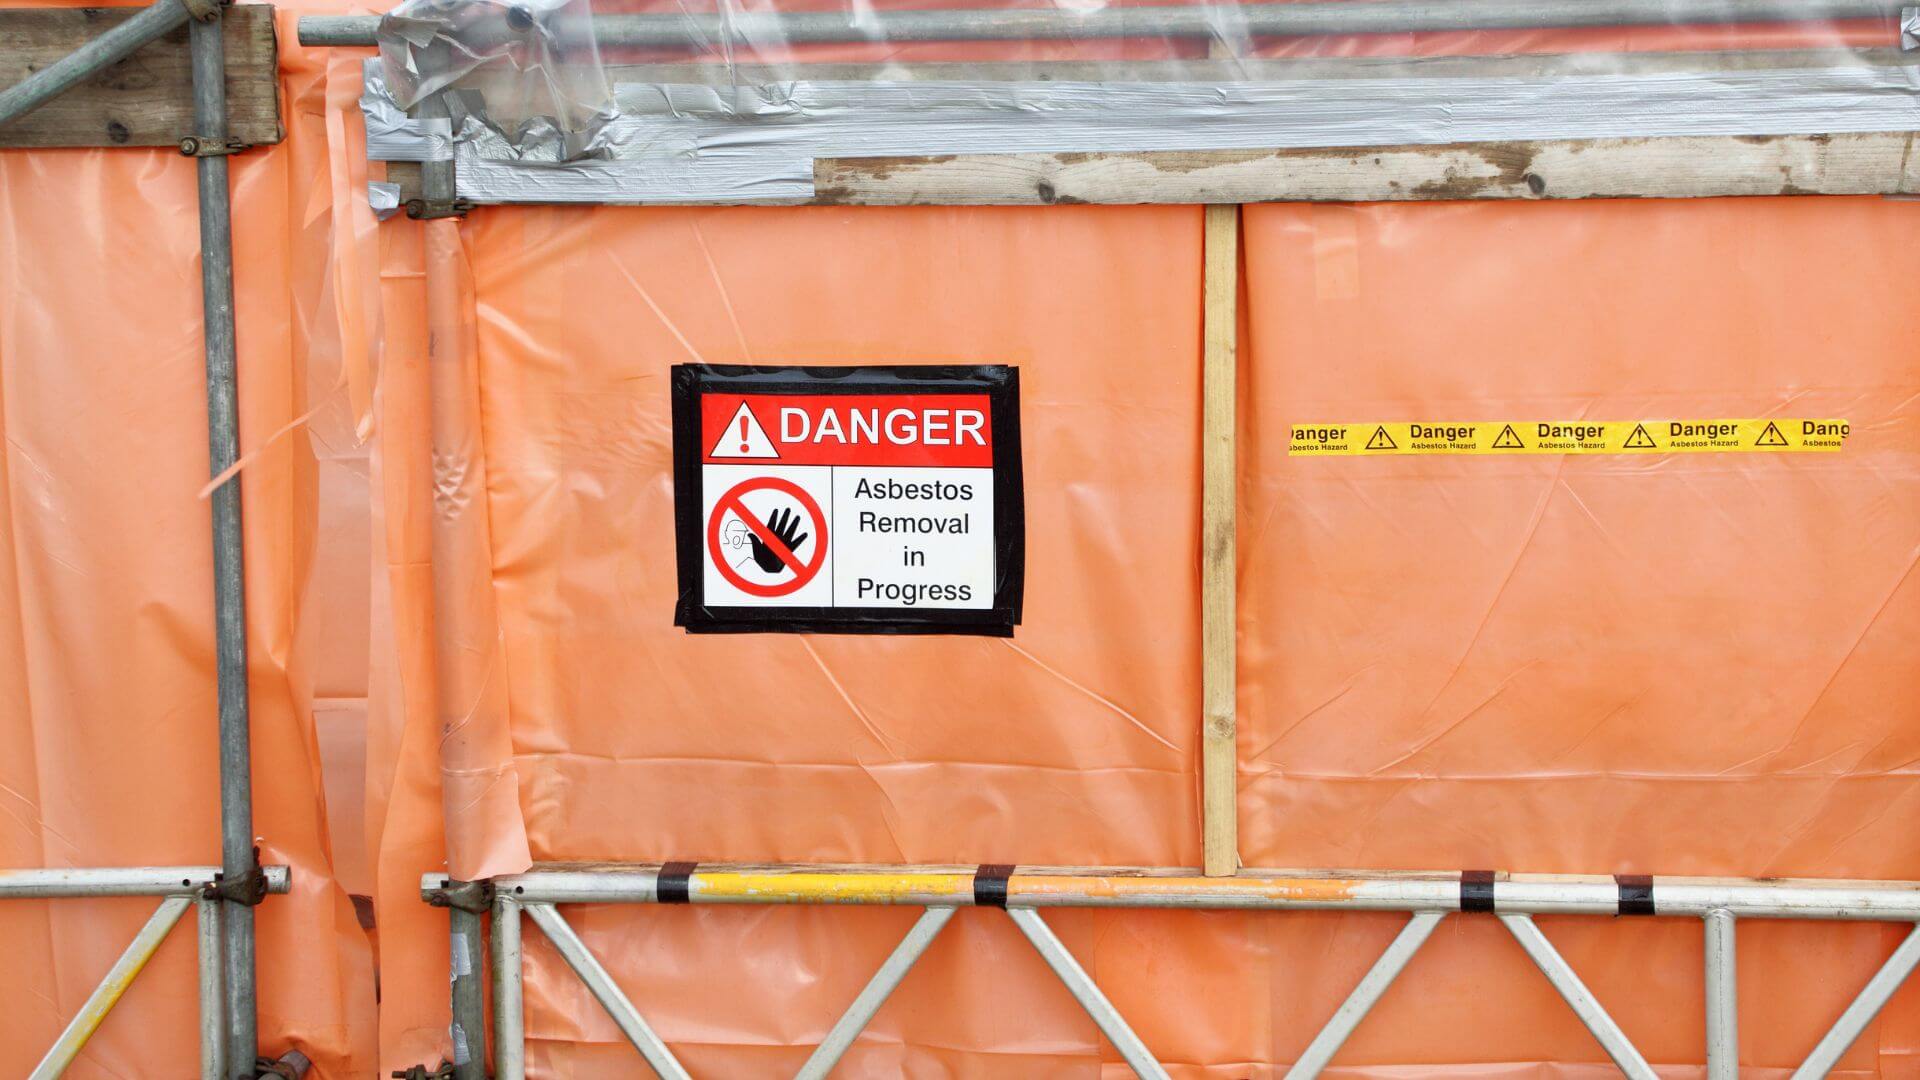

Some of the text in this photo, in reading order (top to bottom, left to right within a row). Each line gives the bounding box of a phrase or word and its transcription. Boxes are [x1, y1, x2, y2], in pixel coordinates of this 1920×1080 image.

[779, 407, 987, 446] DANGER
[1291, 421, 1850, 443] anger Danger Danger Danger Dang
[854, 478, 973, 500] Asbestos
[859, 511, 970, 534] Removal
[903, 546, 925, 567] in
[857, 578, 972, 605] Progress
